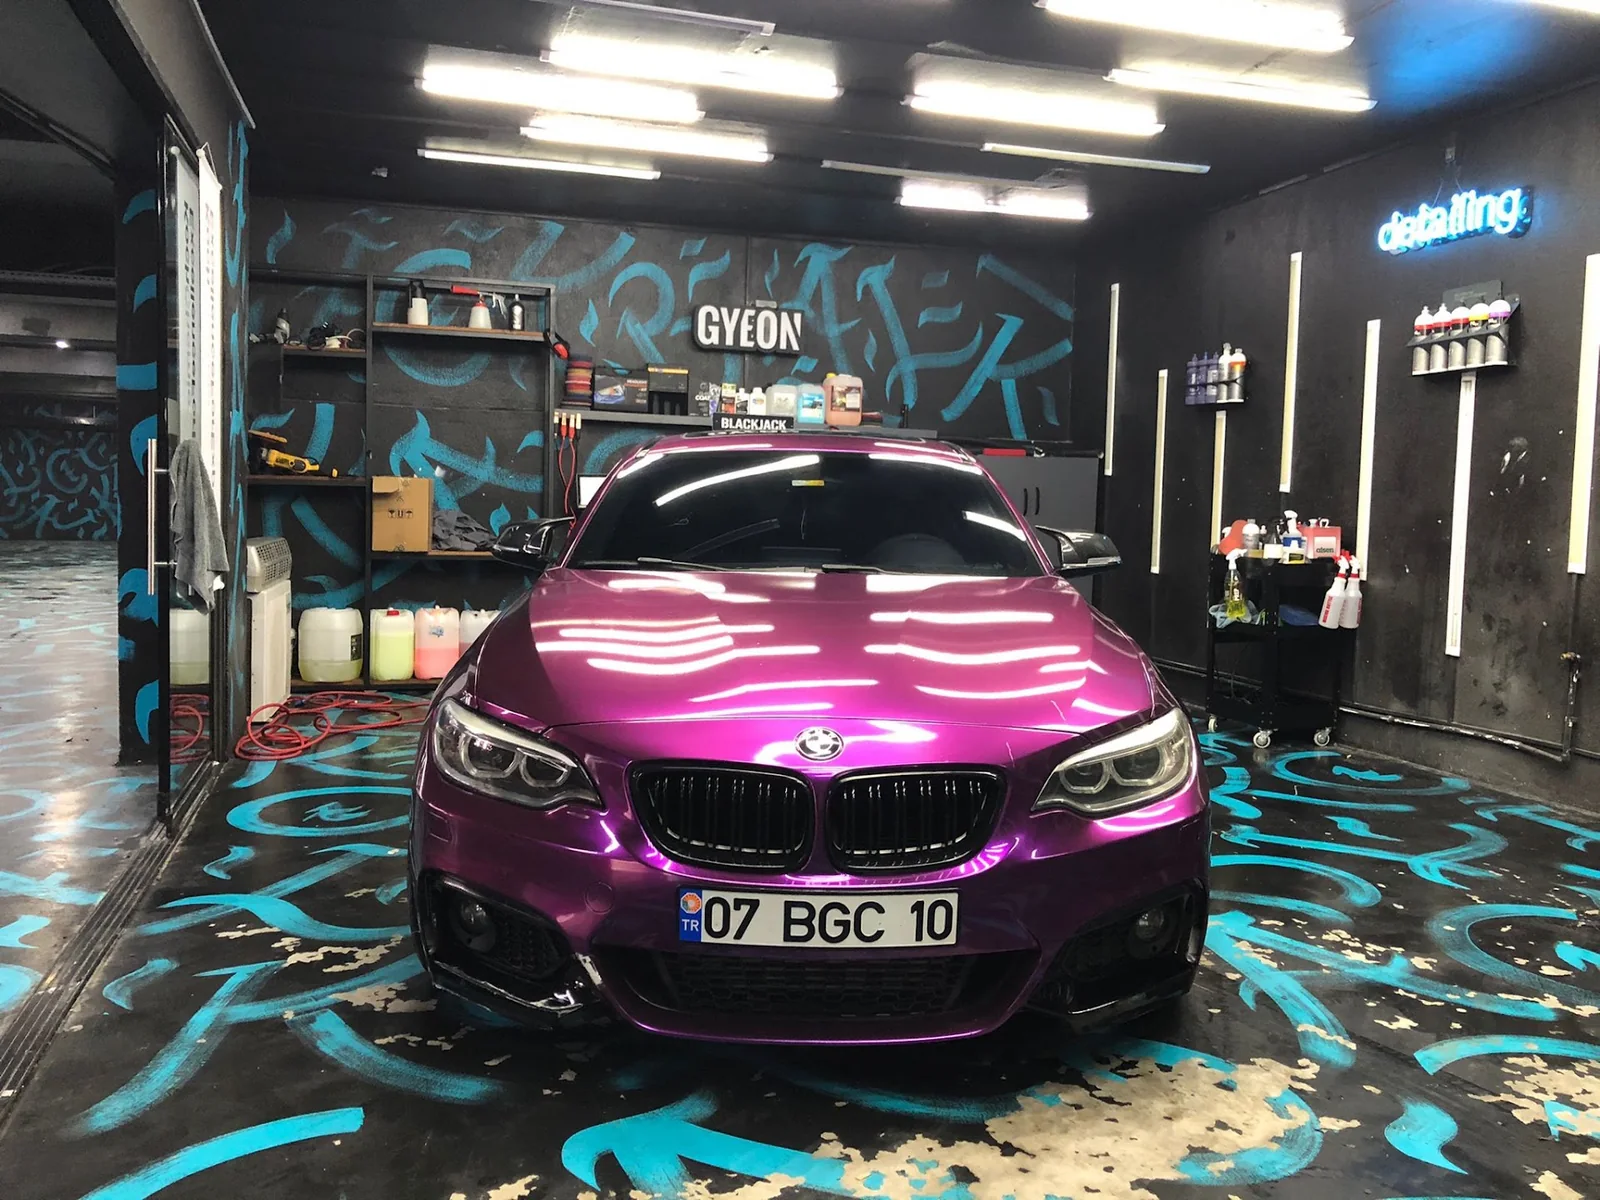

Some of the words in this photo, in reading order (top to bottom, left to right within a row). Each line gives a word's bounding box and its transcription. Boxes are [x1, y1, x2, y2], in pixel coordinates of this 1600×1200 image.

[1378, 188, 1523, 251] detailing
[721, 417, 787, 430] BLACKJACK
[681, 919, 700, 932] TR
[704, 896, 760, 940] 07
[783, 900, 886, 943] BGC
[910, 899, 954, 942] 10
